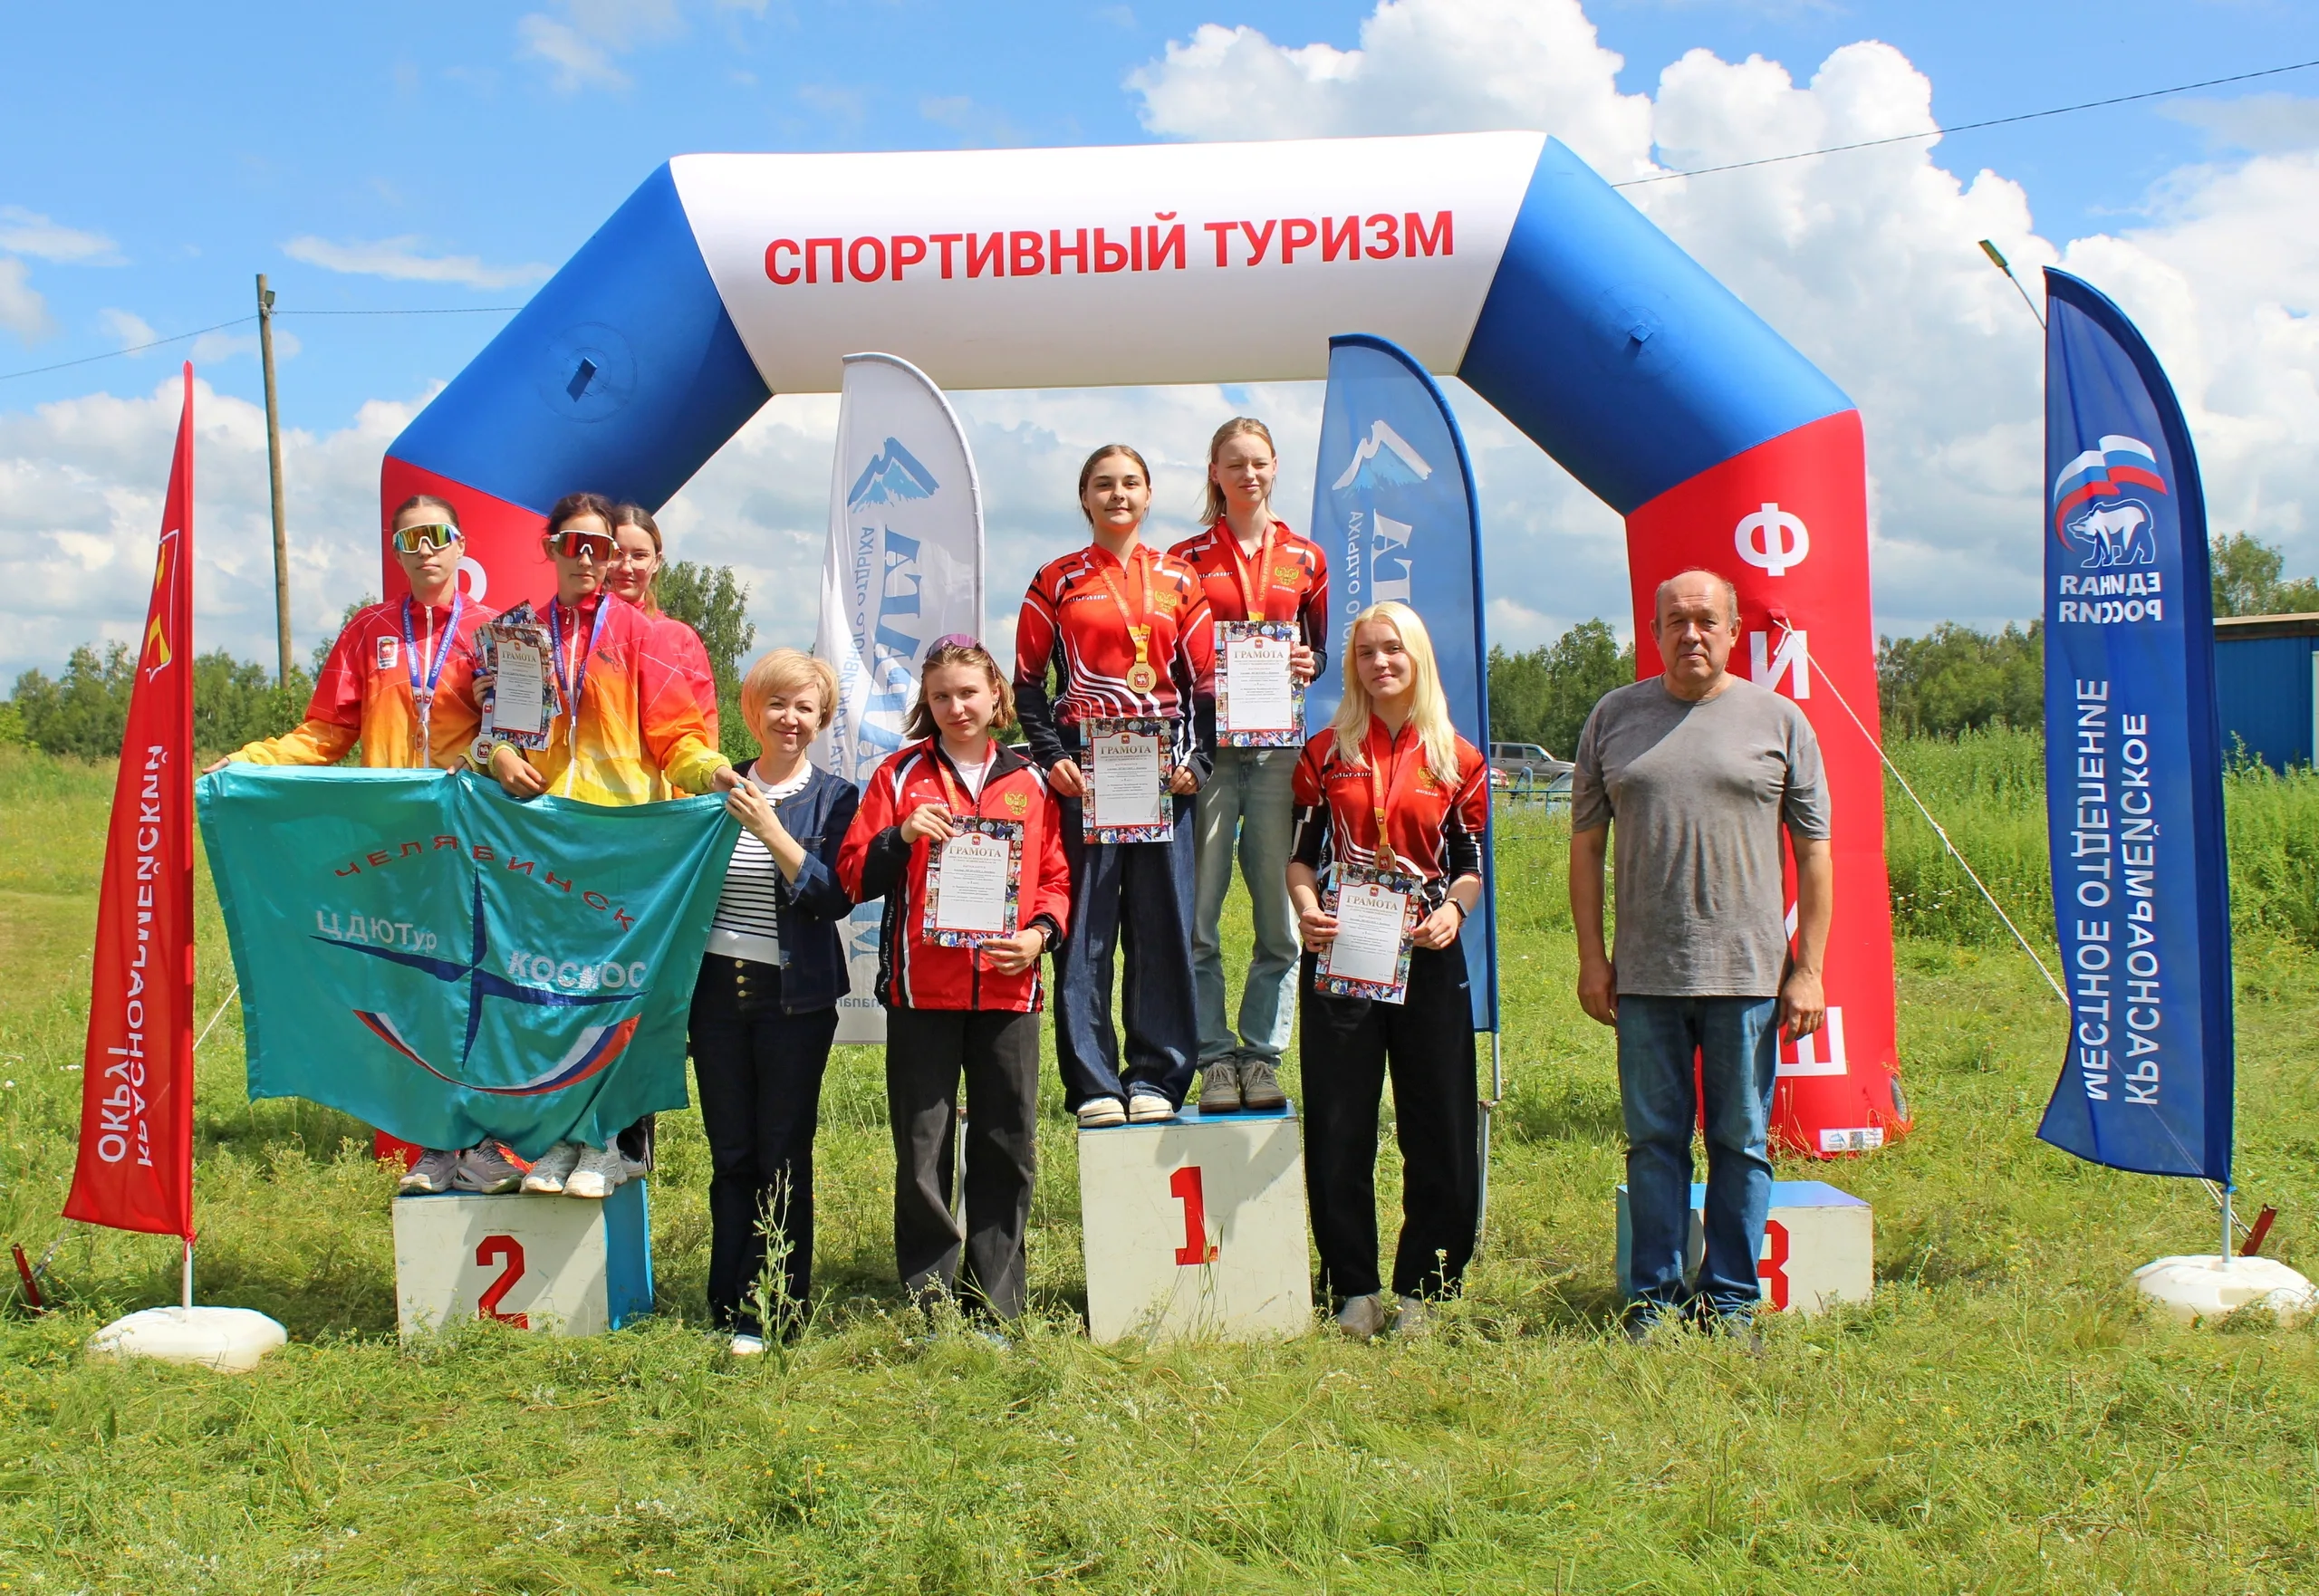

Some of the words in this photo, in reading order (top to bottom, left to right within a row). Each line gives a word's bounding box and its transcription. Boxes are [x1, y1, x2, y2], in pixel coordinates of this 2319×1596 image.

[765, 211, 1187, 285] СПОРТИВНЫЙ
[1203, 210, 1454, 267] ТУРИЗМ
[431, 650, 445, 678] ОБЛАСТЬ
[502, 651, 537, 663] ГРАМОТА
[1234, 649, 1285, 659] ГРАМОТА
[1100, 745, 1151, 755] ГРАМОТА
[948, 845, 1002, 858] ГРАМОТА
[334, 834, 635, 932] ЧЕЛЯБИНСК
[1346, 895, 1399, 911] ГРАМОТА
[507, 951, 647, 990] КОСМОС
[476, 1235, 529, 1330] 2
